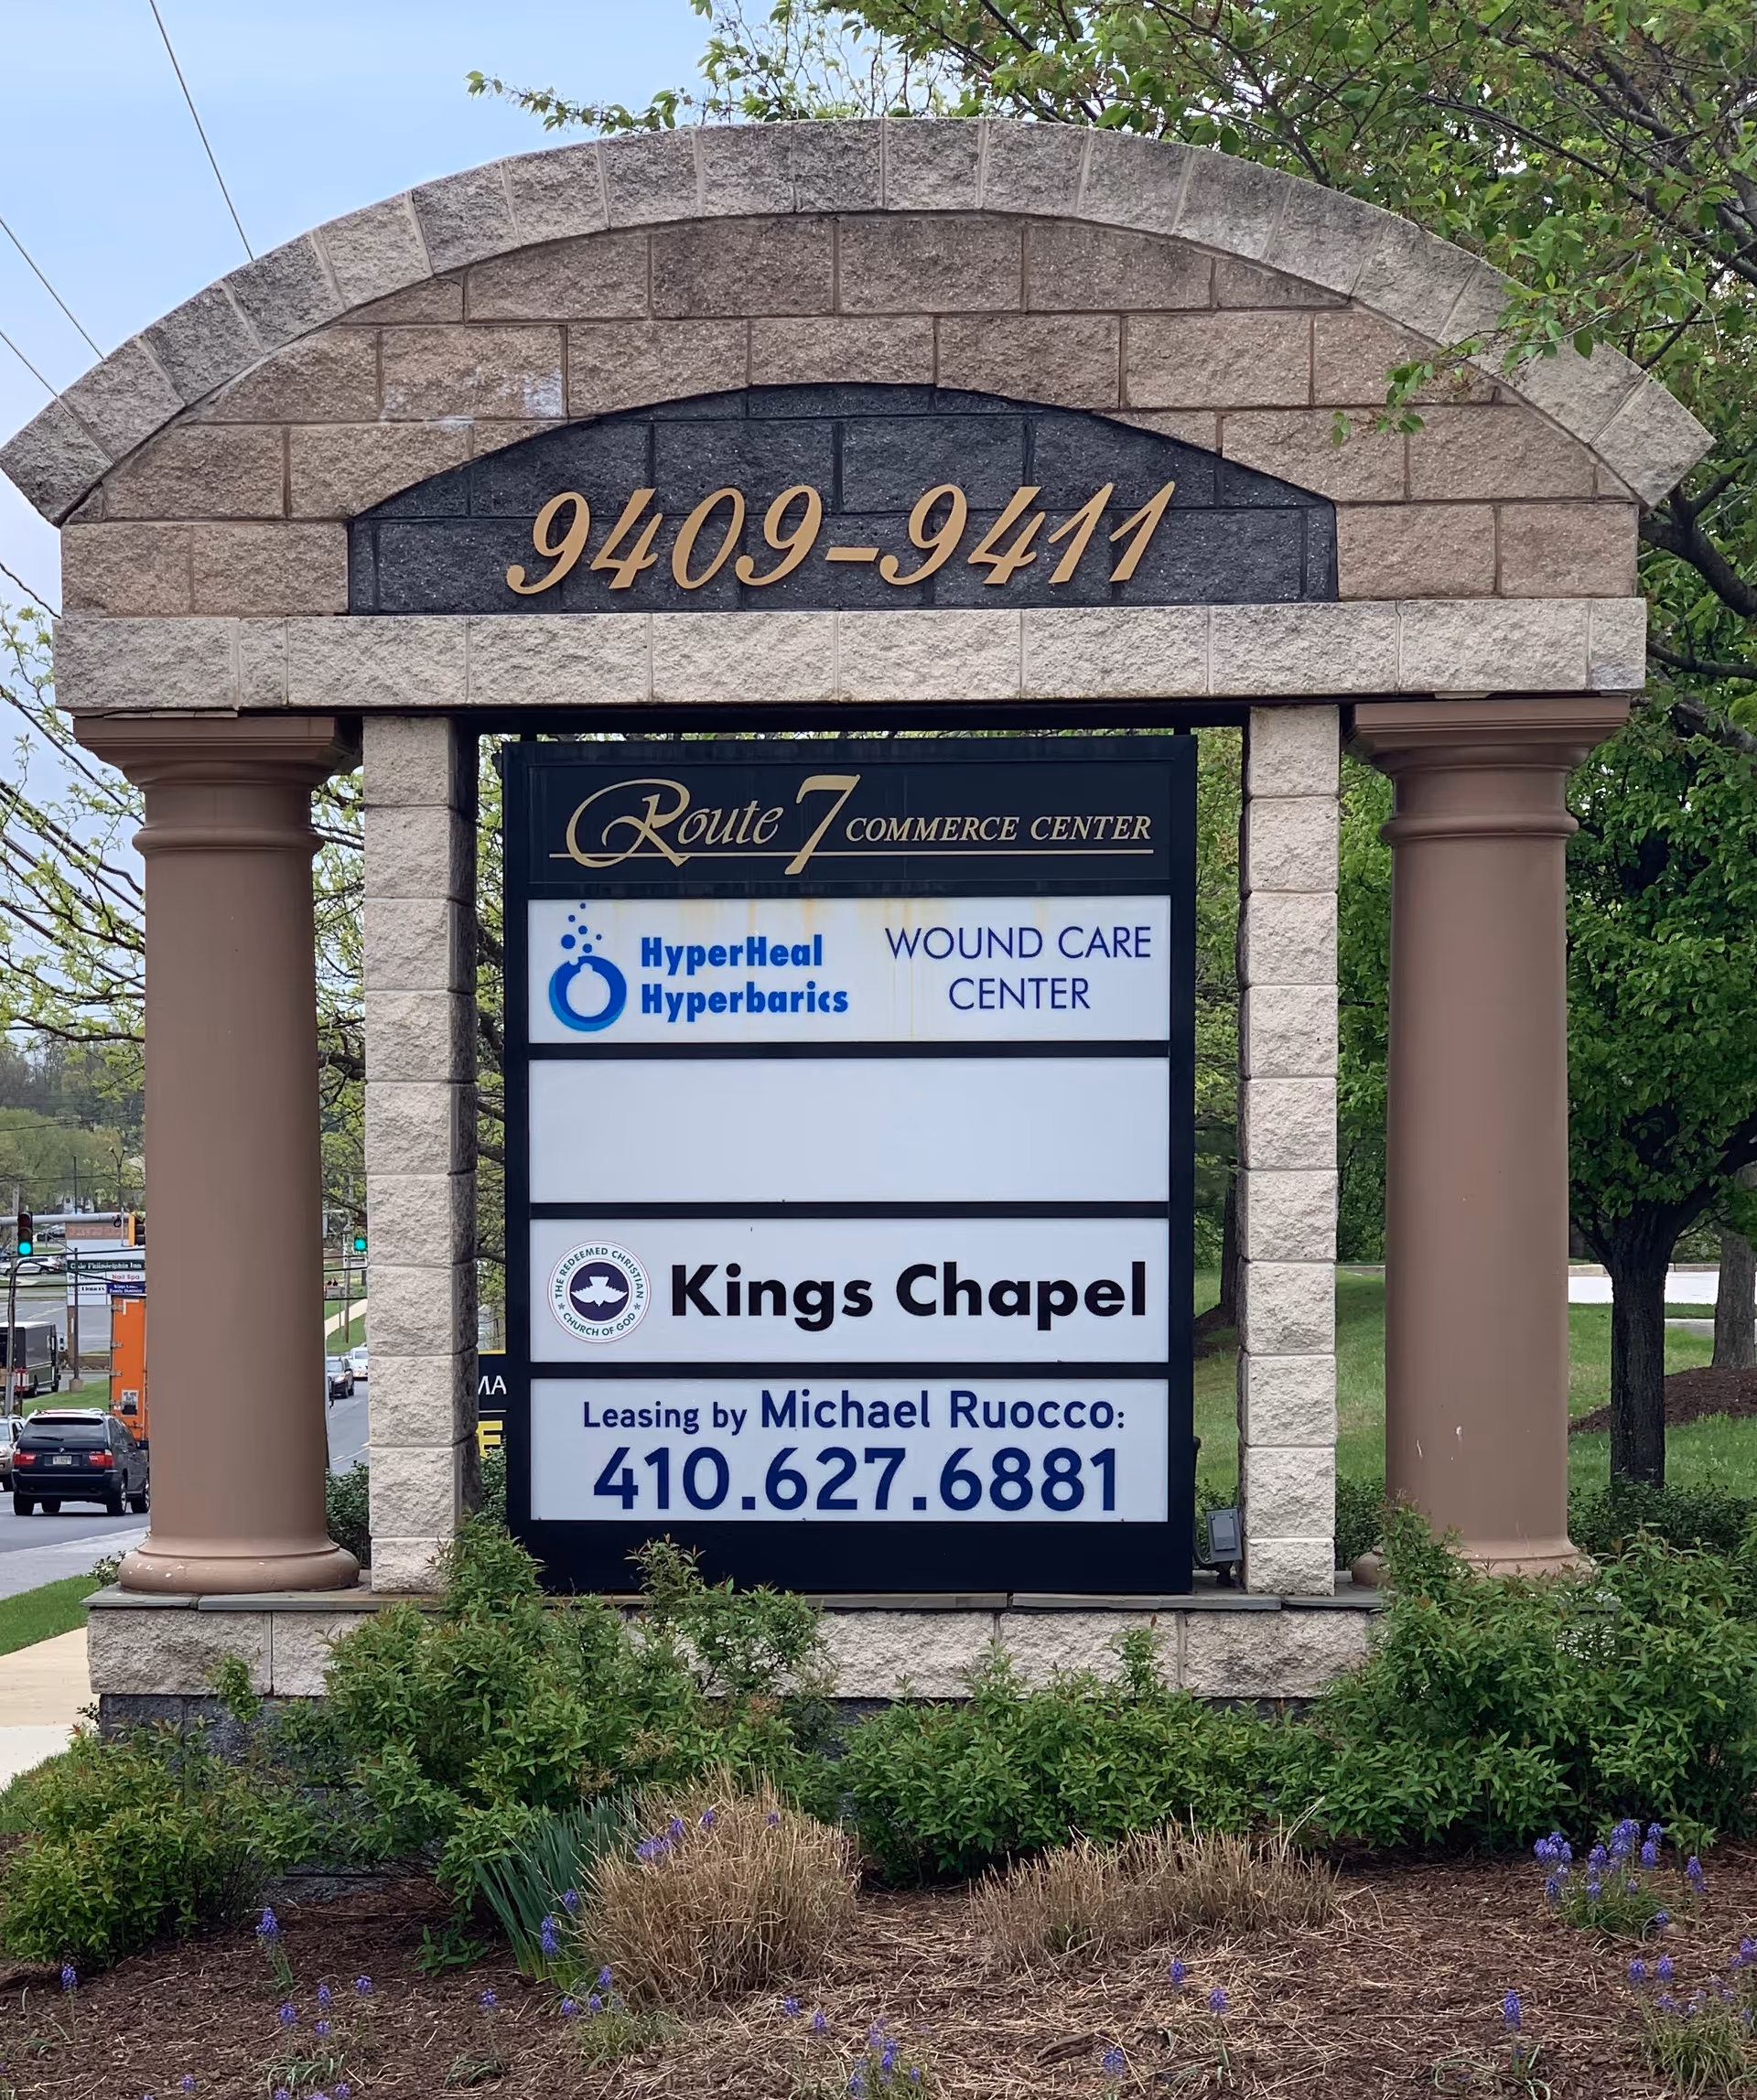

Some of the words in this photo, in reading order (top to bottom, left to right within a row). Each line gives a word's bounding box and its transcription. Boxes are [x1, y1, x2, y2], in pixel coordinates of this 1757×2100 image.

[506, 481, 1176, 596] 9409-9411
[566, 778, 783, 867] Route
[784, 774, 861, 876] 7
[846, 816, 1018, 842] COMMERCE
[1029, 815, 1152, 840] CENTER
[641, 934, 824, 976] HyperHeal
[885, 927, 1044, 960] WOUND
[1058, 926, 1152, 960] CARE
[641, 981, 849, 1024] Hyperbarics
[949, 978, 1091, 1011] CENTER
[127, 1273, 140, 1281] Spa
[559, 1247, 609, 1276] REDEEMED
[611, 1250, 644, 1298] CHRISTIAN
[555, 1278, 566, 1298] THE
[673, 1263, 874, 1333] Kings
[896, 1261, 1147, 1332] Chapel
[563, 1312, 600, 1336] CHURCH
[601, 1326, 615, 1336] OF
[616, 1312, 636, 1331] GOD
[584, 1401, 701, 1437] Leasing
[712, 1402, 749, 1437] by
[761, 1389, 932, 1430] Michael
[951, 1390, 1126, 1430] Ruocco:
[593, 1447, 1116, 1513] 410.627.6881
